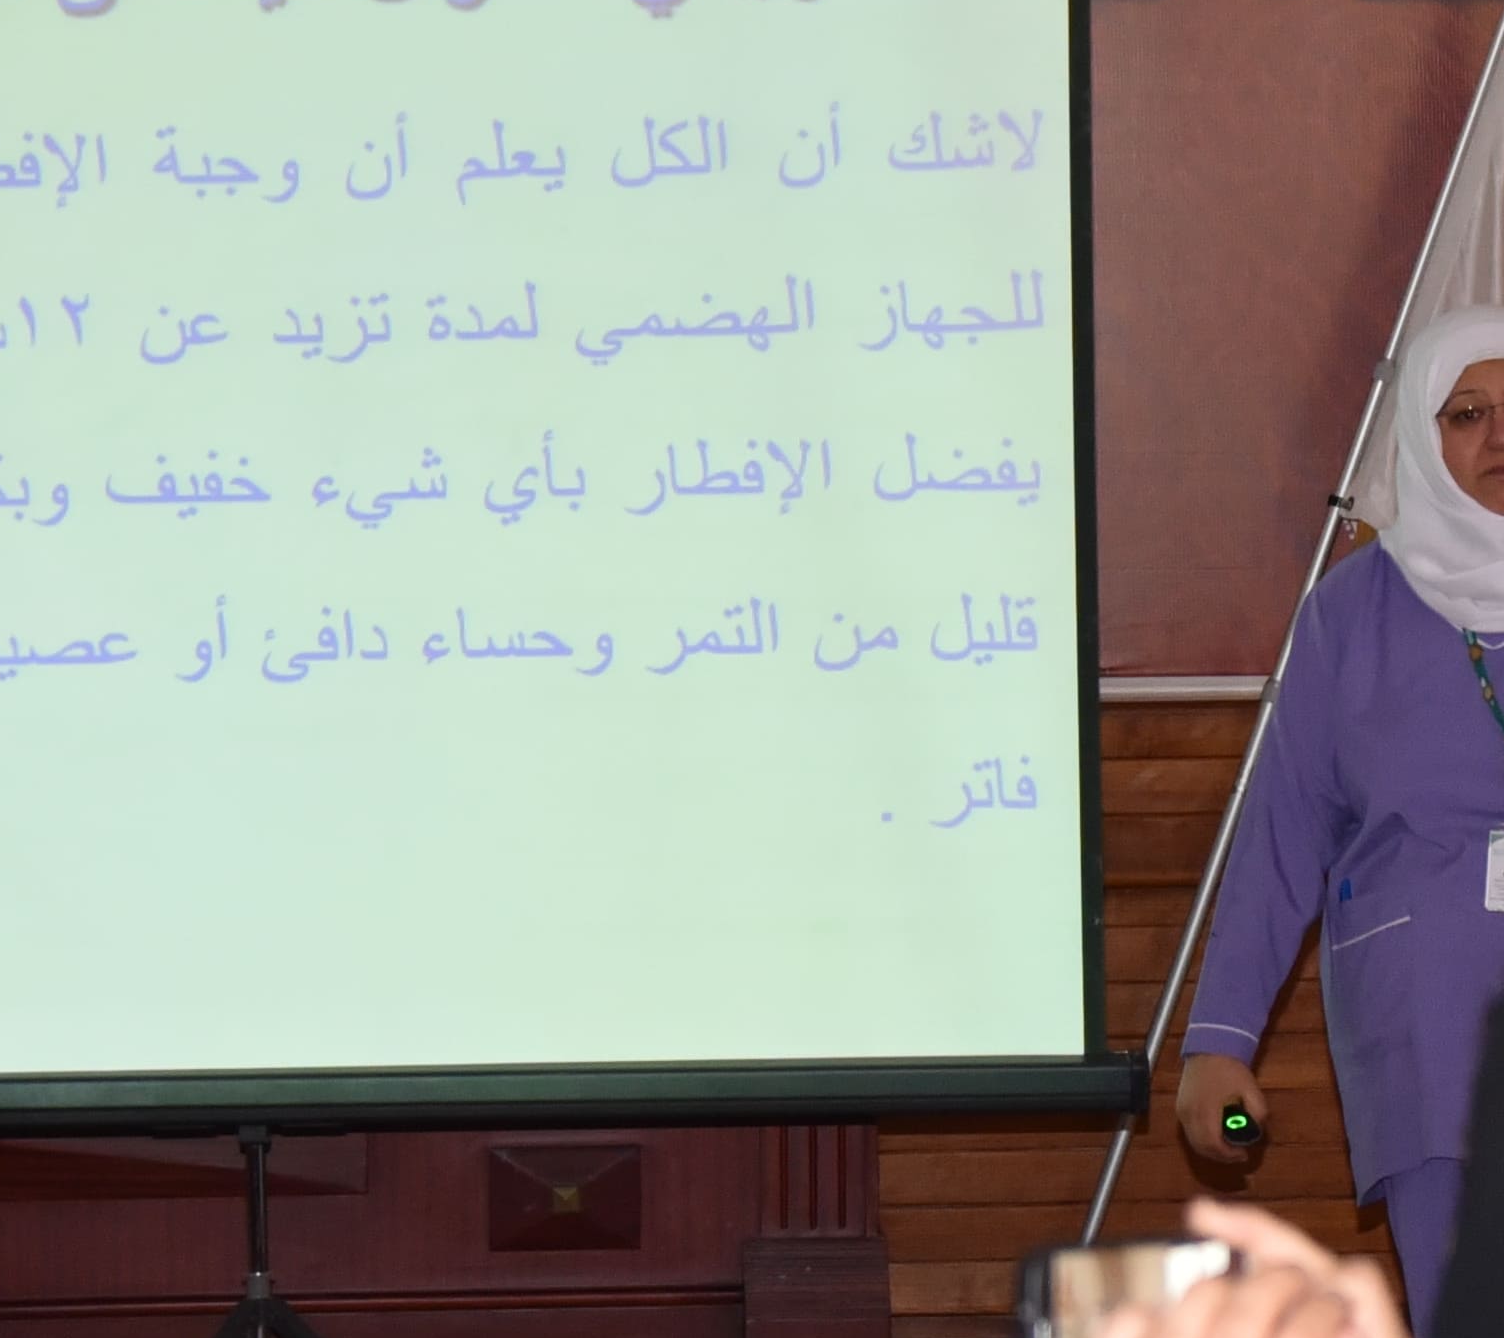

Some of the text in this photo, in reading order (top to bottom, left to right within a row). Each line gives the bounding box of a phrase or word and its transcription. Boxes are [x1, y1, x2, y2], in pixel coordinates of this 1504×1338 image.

[151, 123, 301, 206] وجبة
[344, 110, 409, 203] أن
[455, 117, 567, 203] يعلم
[609, 114, 729, 190] الكل
[777, 101, 843, 191] أن
[887, 109, 1043, 174] لاشك
[138, 304, 229, 368] عن
[272, 291, 392, 365] تزيد
[426, 279, 541, 343] لمدة
[574, 273, 816, 368] الهضمي
[863, 268, 1046, 353] للجهاز
[103, 448, 273, 521] خفيف
[310, 445, 449, 531] شيء
[482, 429, 588, 528] بأي
[628, 437, 833, 518] الإفطار
[872, 431, 1043, 508] يفضل
[179, 595, 229, 685] أو
[420, 606, 616, 679] وحساء
[649, 594, 781, 677] التمر
[812, 611, 901, 674] من
[929, 591, 1040, 667] قليل
[933, 754, 1040, 831] فاتر
